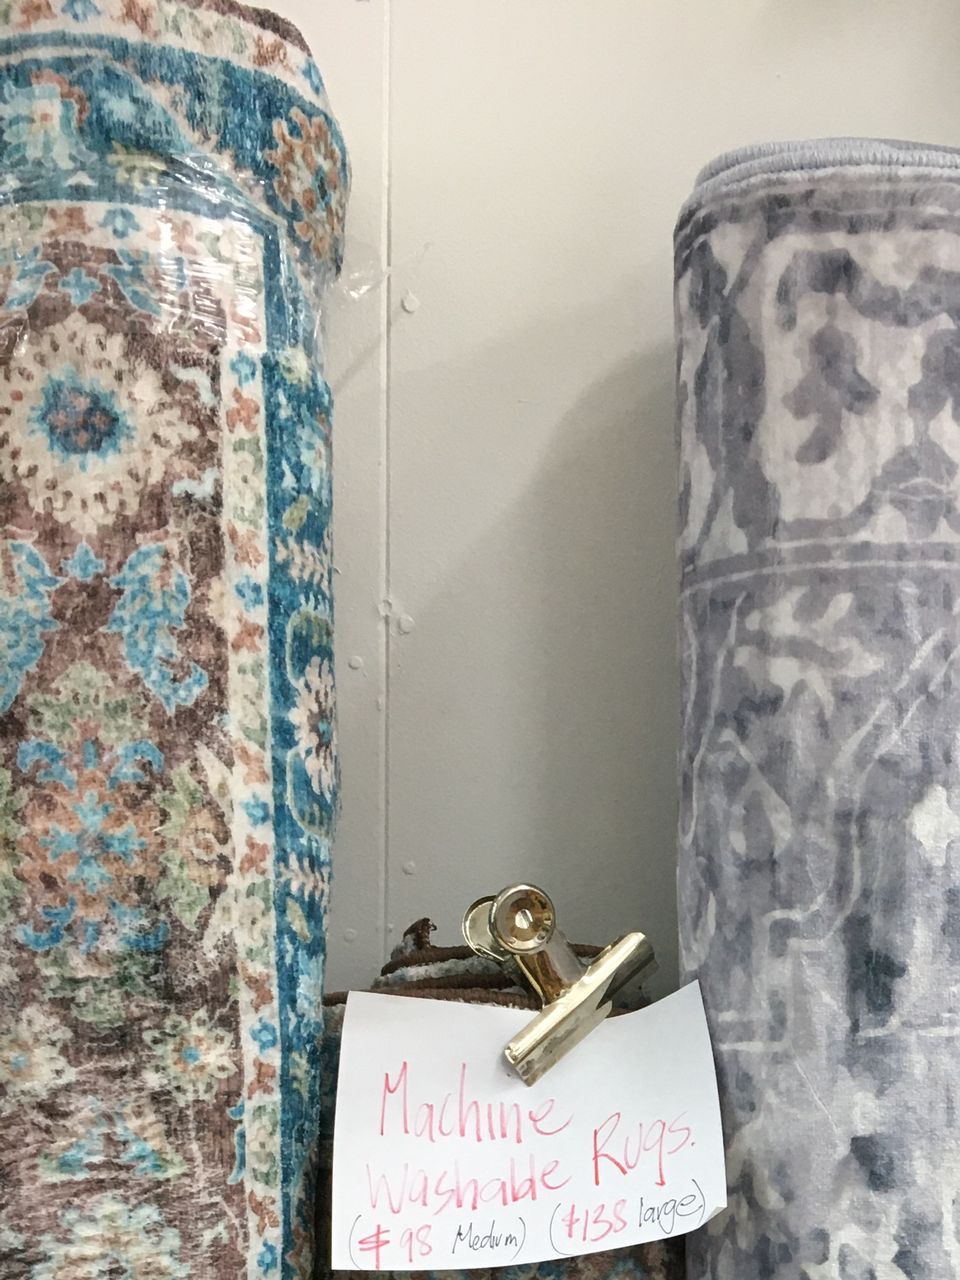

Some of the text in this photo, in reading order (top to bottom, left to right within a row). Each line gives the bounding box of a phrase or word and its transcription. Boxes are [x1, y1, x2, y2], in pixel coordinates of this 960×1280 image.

[380, 1061, 574, 1143] Machine
[366, 1111, 696, 1216] Washable Rugs.
